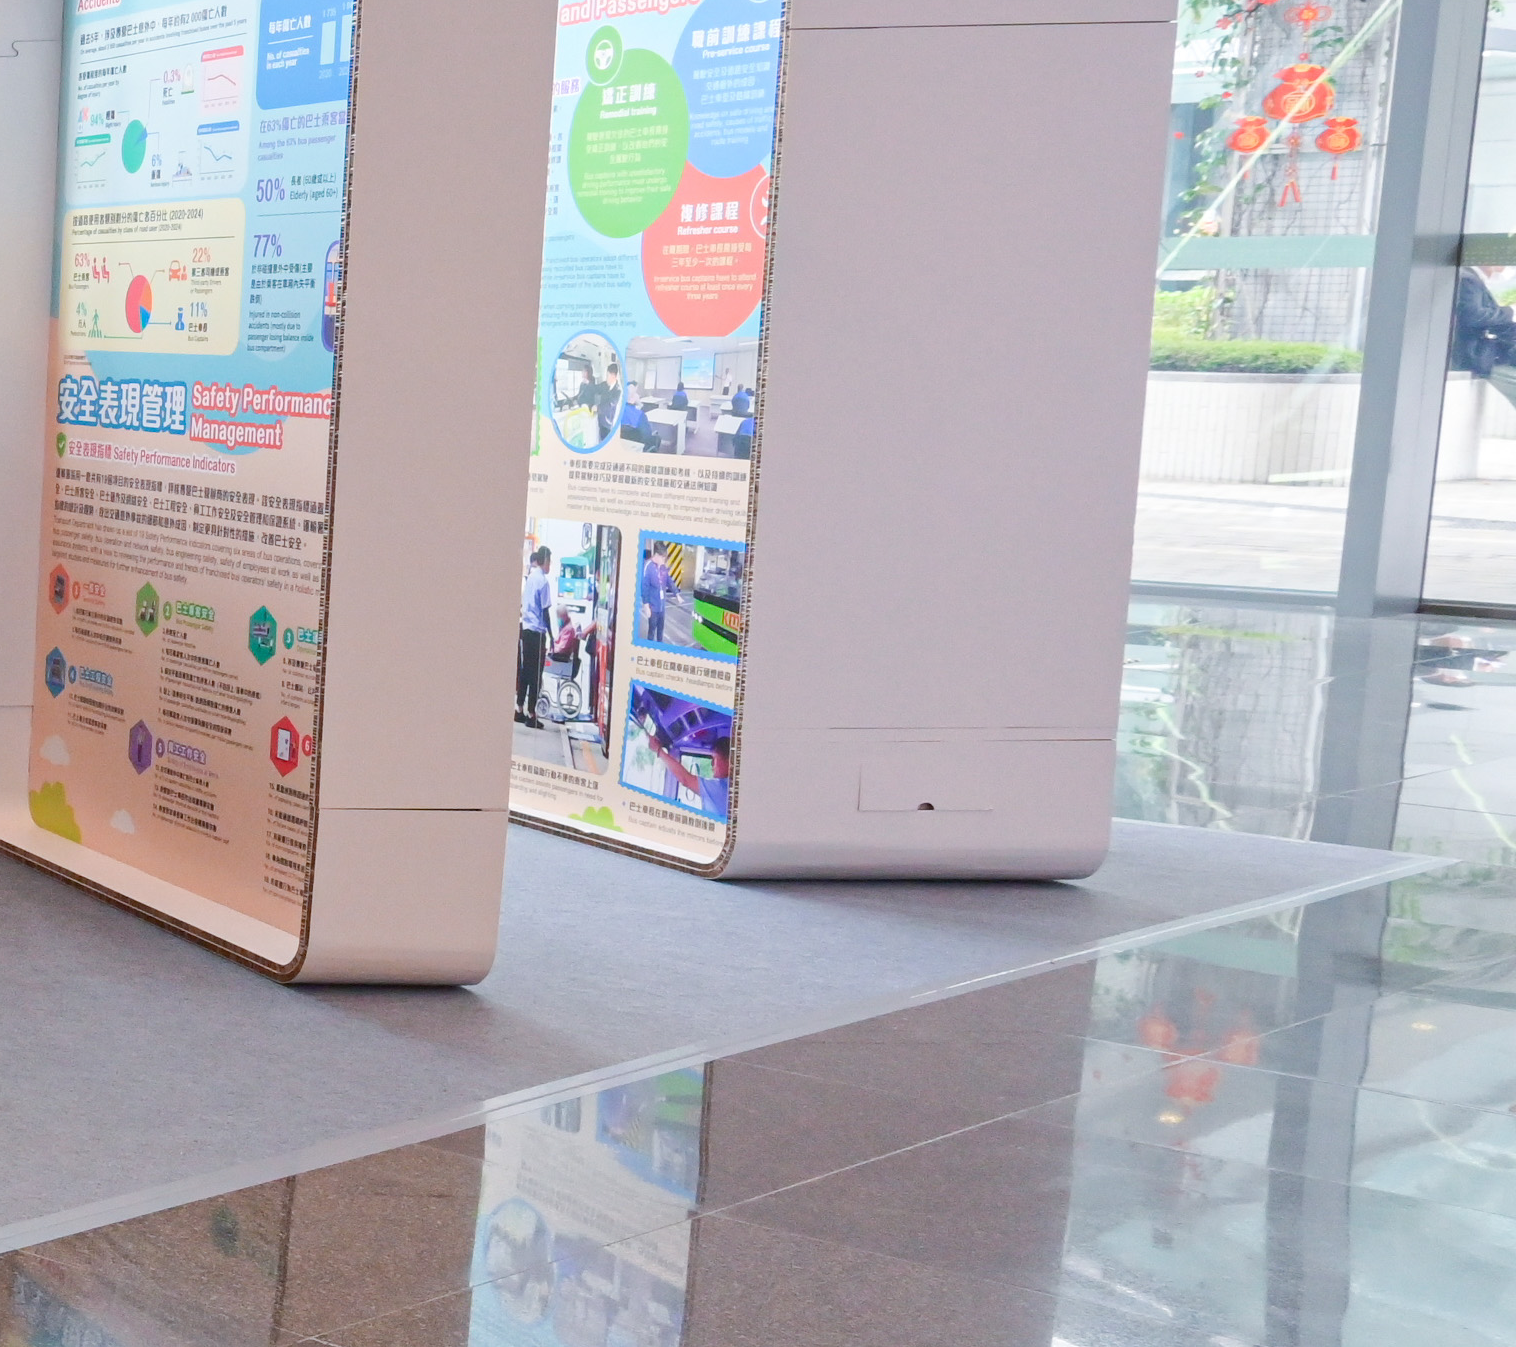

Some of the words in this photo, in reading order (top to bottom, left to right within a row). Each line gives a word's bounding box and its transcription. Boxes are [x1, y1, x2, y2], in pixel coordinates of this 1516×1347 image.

[561, 3, 589, 23] and
[256, 177, 285, 202] 50%
[681, 202, 738, 222] 複修課程
[714, 226, 738, 234] course
[193, 247, 211, 263] 22%
[254, 234, 282, 258] 77%
[75, 253, 90, 267] 63%
[76, 302, 87, 316] 4%
[190, 302, 207, 317] 11%
[59, 378, 186, 431] 安全表現管理
[193, 384, 239, 413] Safety
[191, 417, 282, 445] Management
[113, 448, 138, 465] Safety
[140, 450, 190, 468] Performance
[193, 456, 235, 473] Indicators
